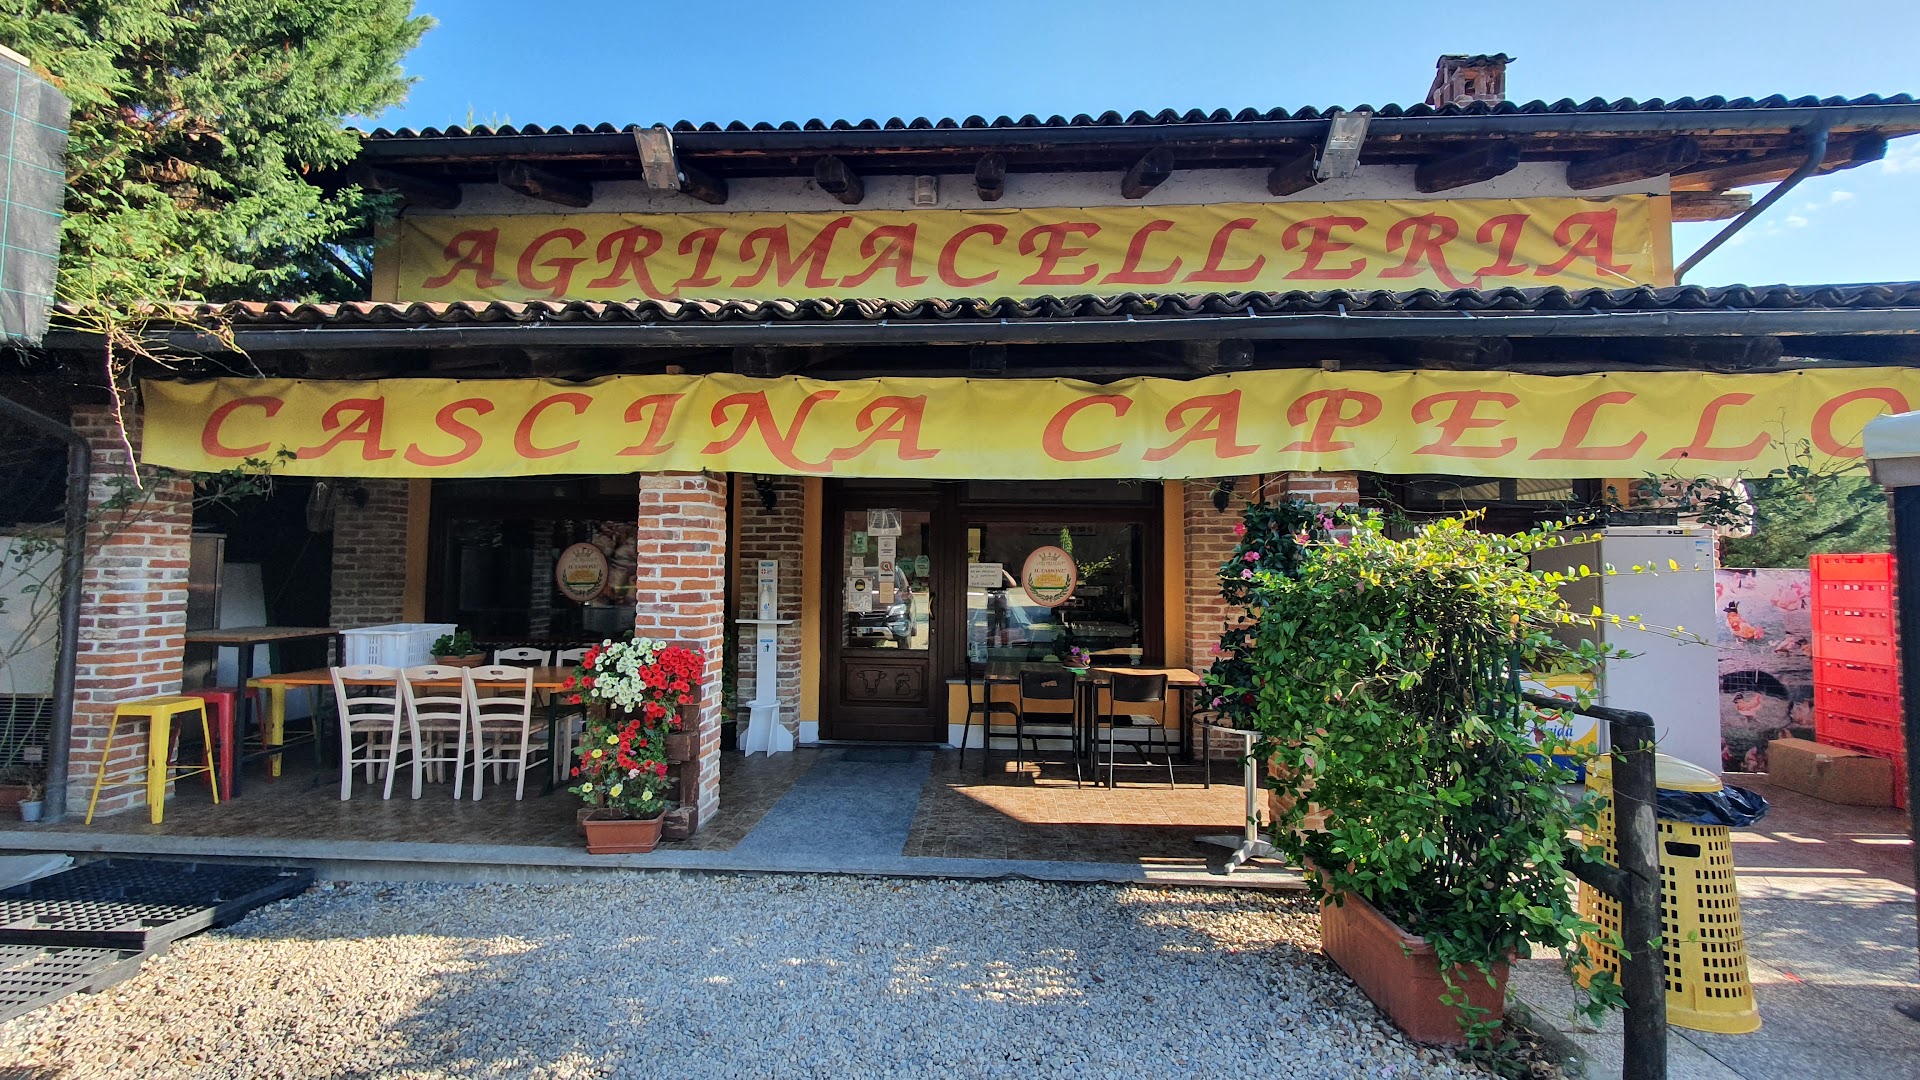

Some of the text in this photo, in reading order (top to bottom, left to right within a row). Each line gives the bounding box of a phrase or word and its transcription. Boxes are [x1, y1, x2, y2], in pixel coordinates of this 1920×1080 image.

[424, 206, 1632, 300] AGRIMACELLERIA
[202, 386, 1911, 478] CASCINA CAPELLO
